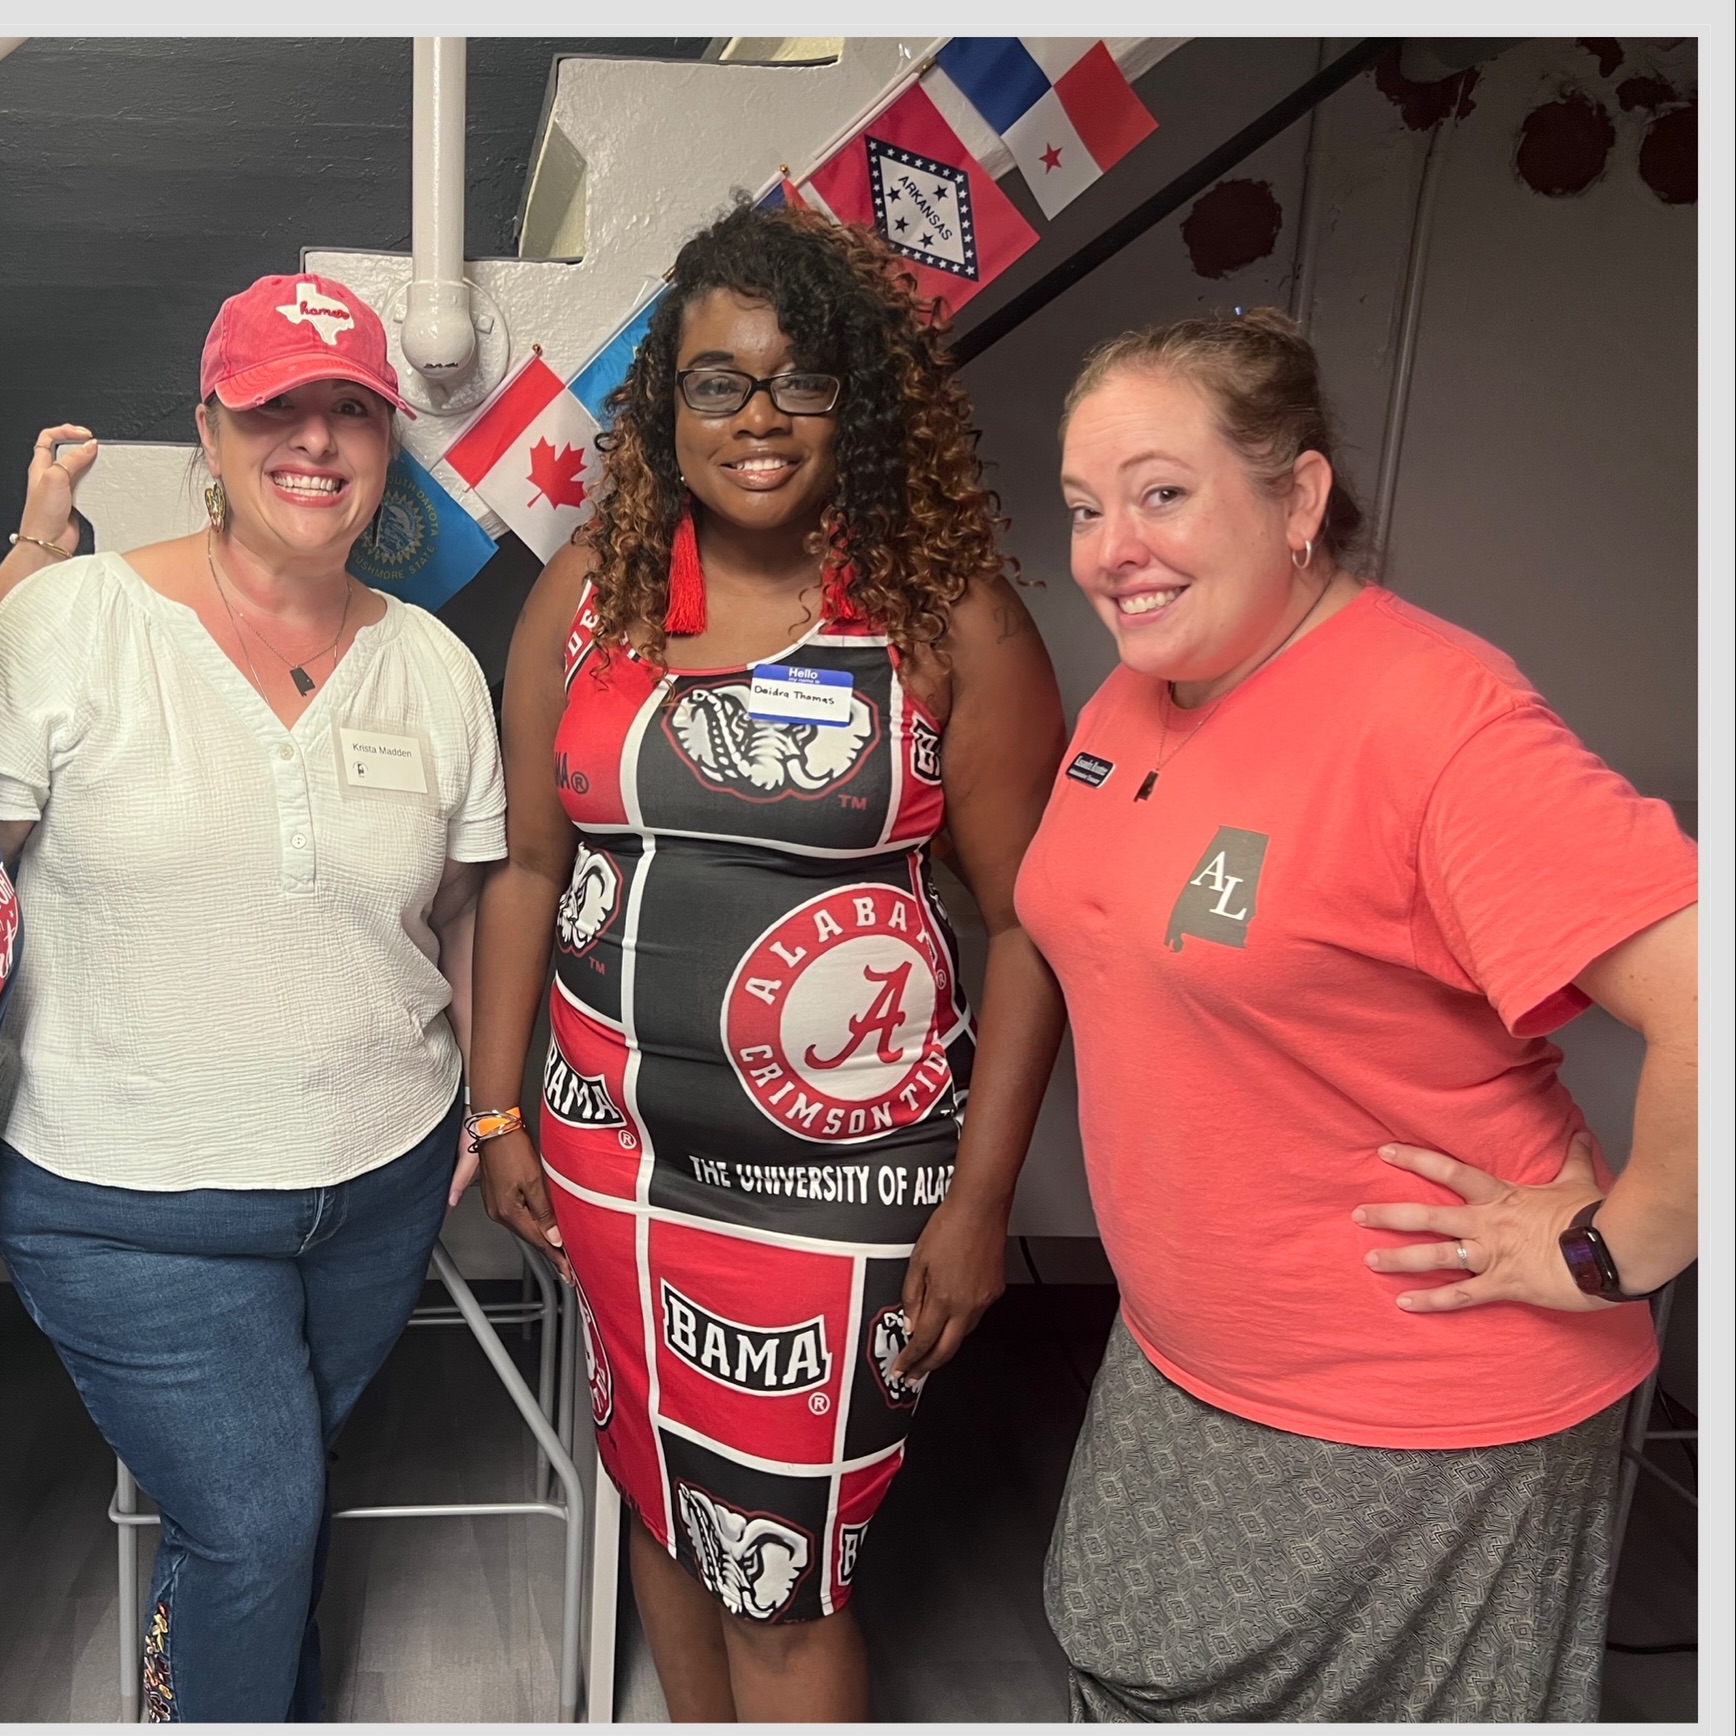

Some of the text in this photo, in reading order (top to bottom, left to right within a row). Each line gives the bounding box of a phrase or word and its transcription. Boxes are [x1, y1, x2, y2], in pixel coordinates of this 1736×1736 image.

[898, 175, 953, 241] ARKANSAS
[408, 544, 435, 575] STATE
[788, 667, 818, 679] Hello
[793, 690, 835, 704] Thomas
[352, 743, 412, 758] Krista Madden
[740, 1044, 893, 1135] CRIMSON
[689, 1155, 731, 1187] THE
[735, 1163, 869, 1203] UNIVERSITY
[878, 1165, 909, 1206] OF
[666, 1294, 824, 1387] BAMA
